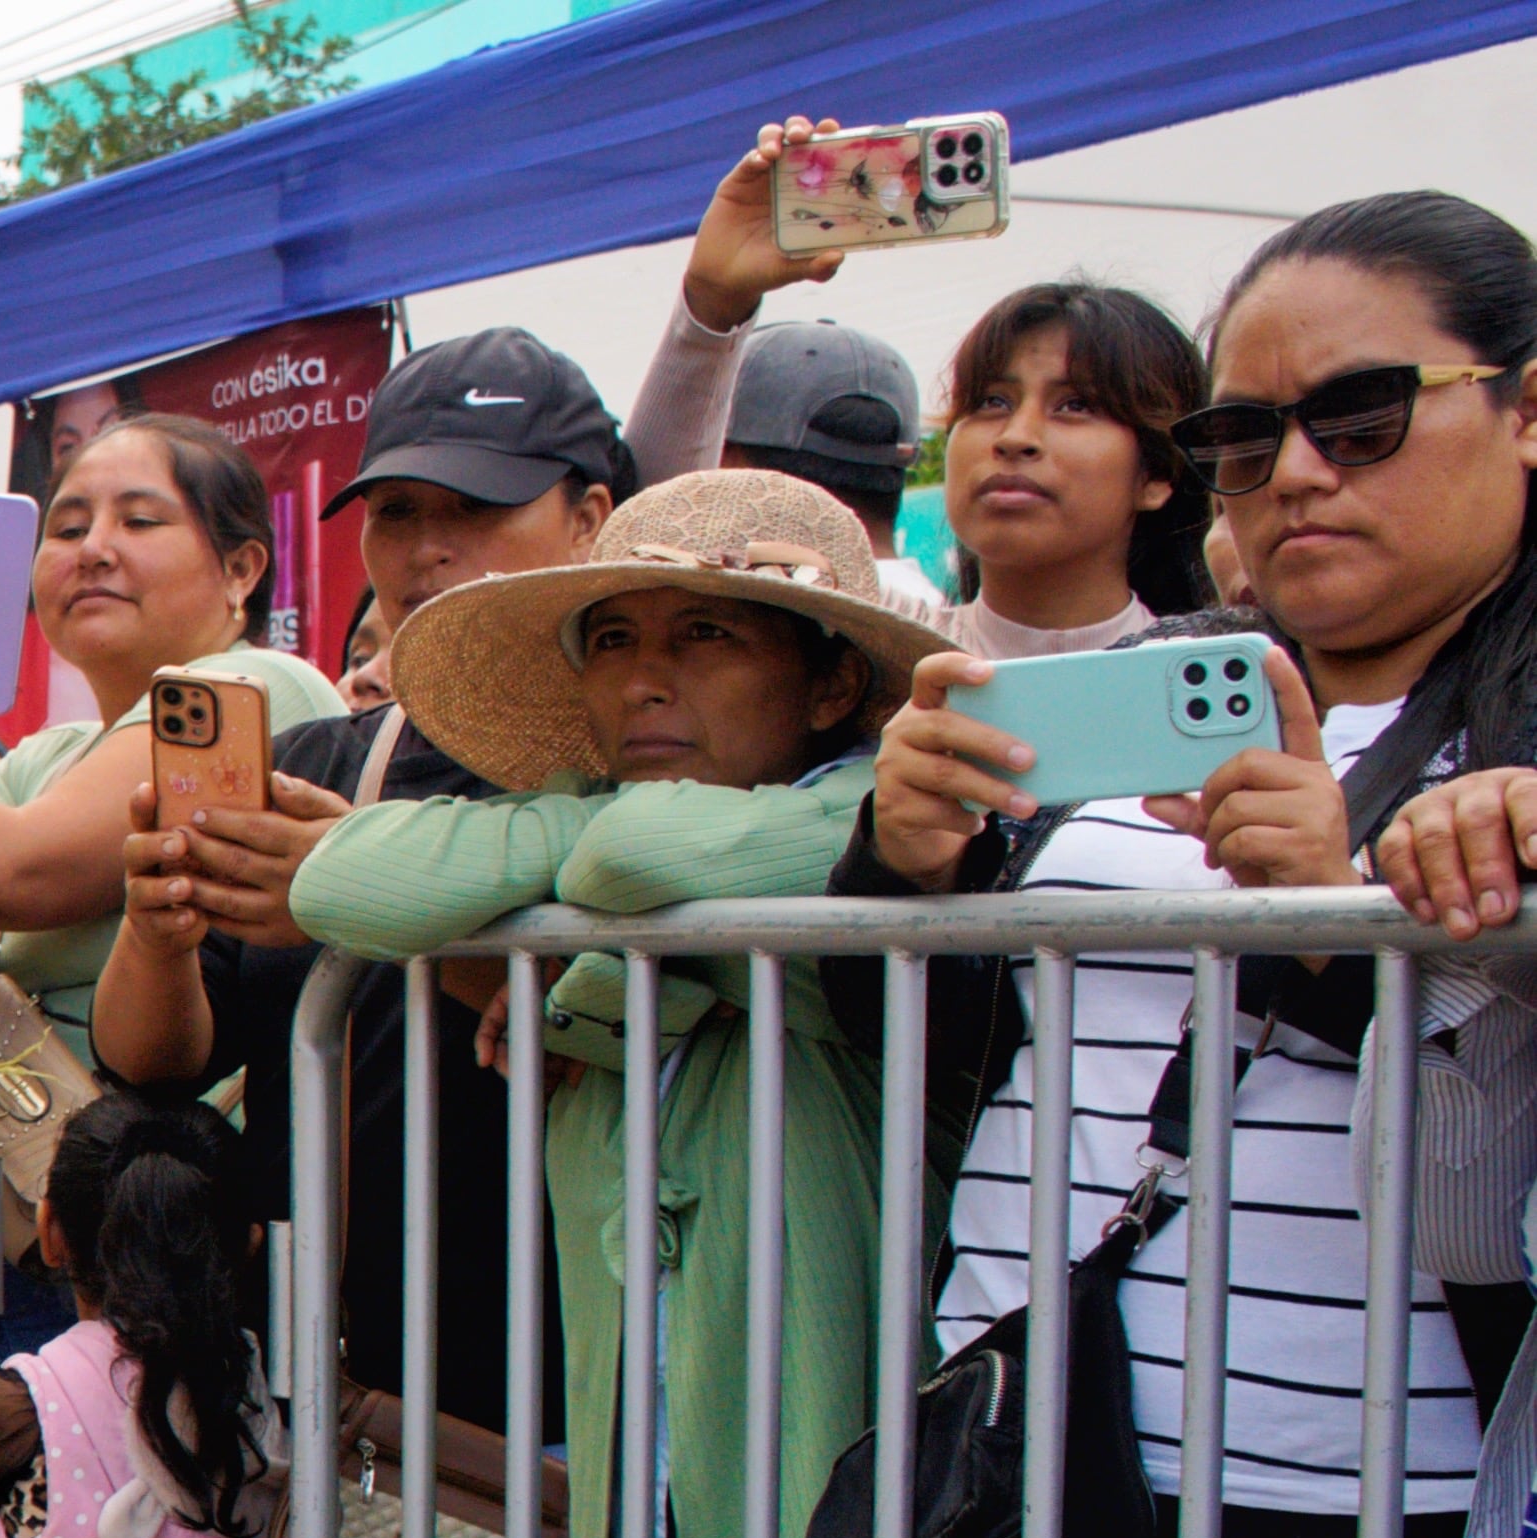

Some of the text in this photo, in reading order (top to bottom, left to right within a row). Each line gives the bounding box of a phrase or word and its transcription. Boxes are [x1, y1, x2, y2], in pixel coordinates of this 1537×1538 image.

[212, 377, 247, 409] CON
[259, 403, 309, 436] TODO
[313, 399, 340, 427] EL
